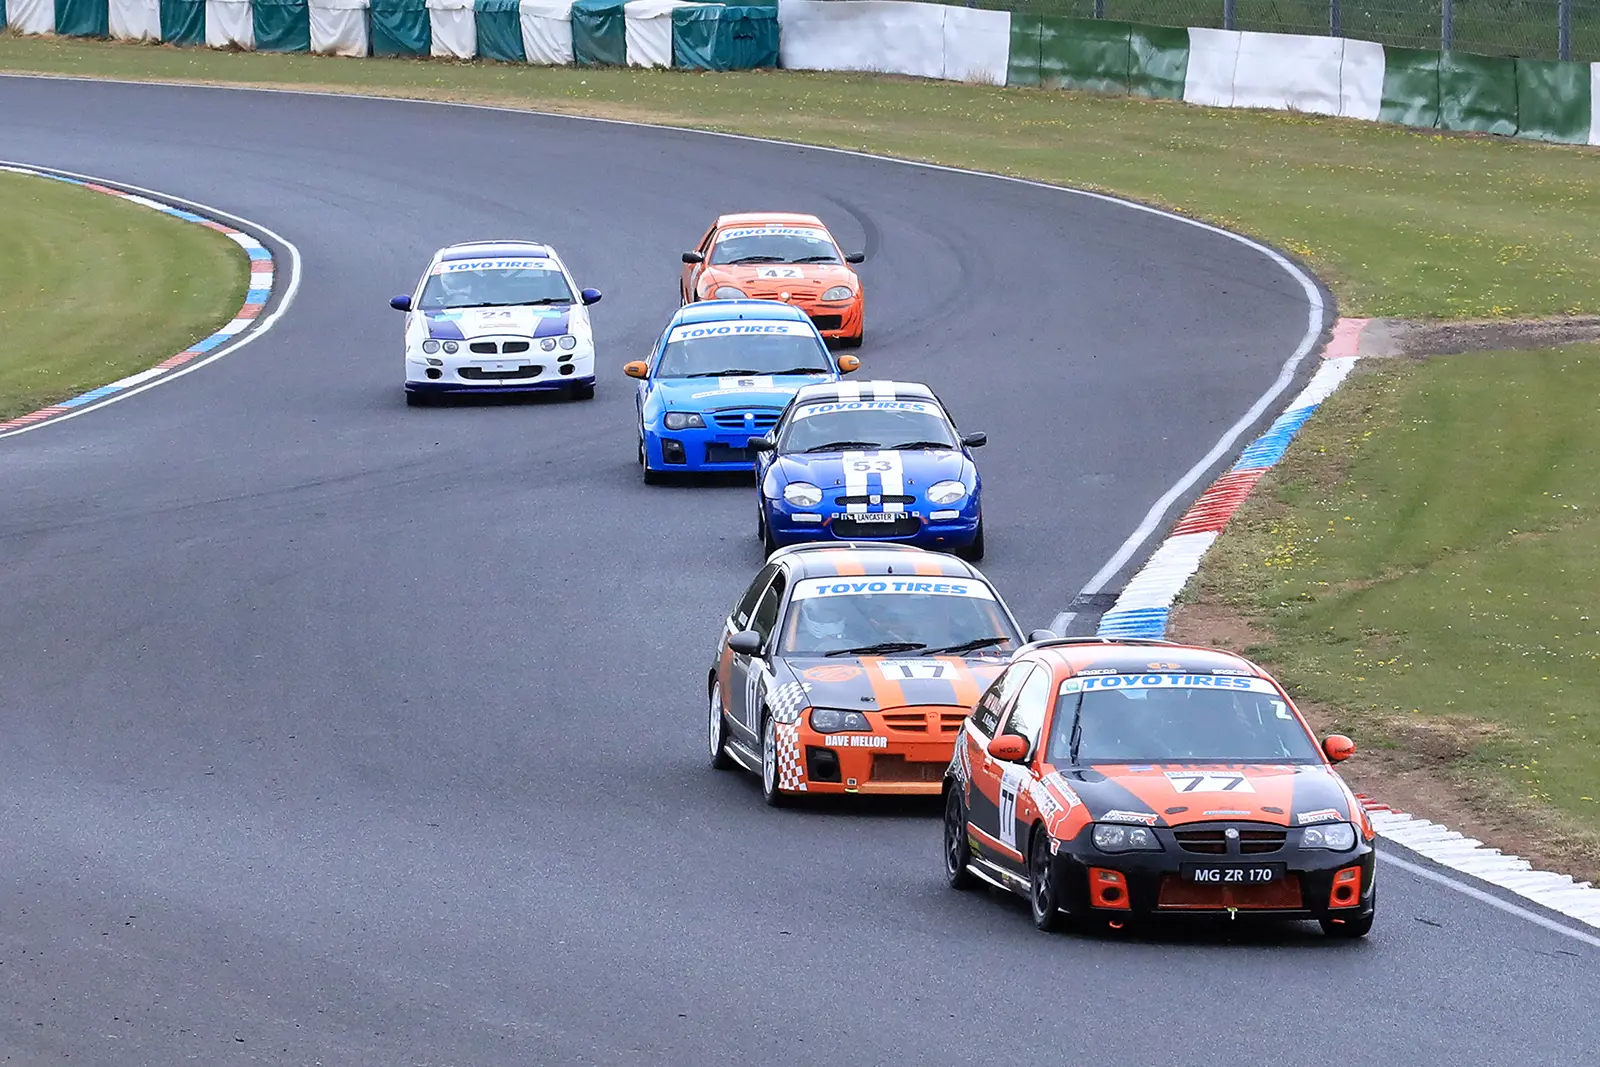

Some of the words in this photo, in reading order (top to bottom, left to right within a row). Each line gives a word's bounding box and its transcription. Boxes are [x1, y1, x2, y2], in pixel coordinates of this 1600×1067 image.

[725, 229, 766, 239] TOYO
[448, 262, 493, 271] TOYO
[764, 269, 797, 277] 42
[681, 326, 731, 338] TOYO
[734, 325, 789, 333] TIRES
[808, 403, 862, 414] TOYO
[866, 402, 926, 411] TIRES
[853, 460, 892, 471] 53
[857, 513, 892, 521] LANCASTER
[816, 582, 887, 595] TOYO
[892, 582, 968, 595] TIRES
[900, 665, 944, 677] 17
[1082, 674, 1163, 689] TOYO
[1167, 675, 1251, 689] TIRES
[825, 735, 849, 747] DAVE
[850, 735, 888, 748] MELLOR
[1170, 775, 1245, 793] 77
[1001, 788, 1015, 837] 77
[1195, 869, 1220, 881] MG
[1224, 869, 1243, 881] ZR
[1249, 868, 1272, 881] 170
